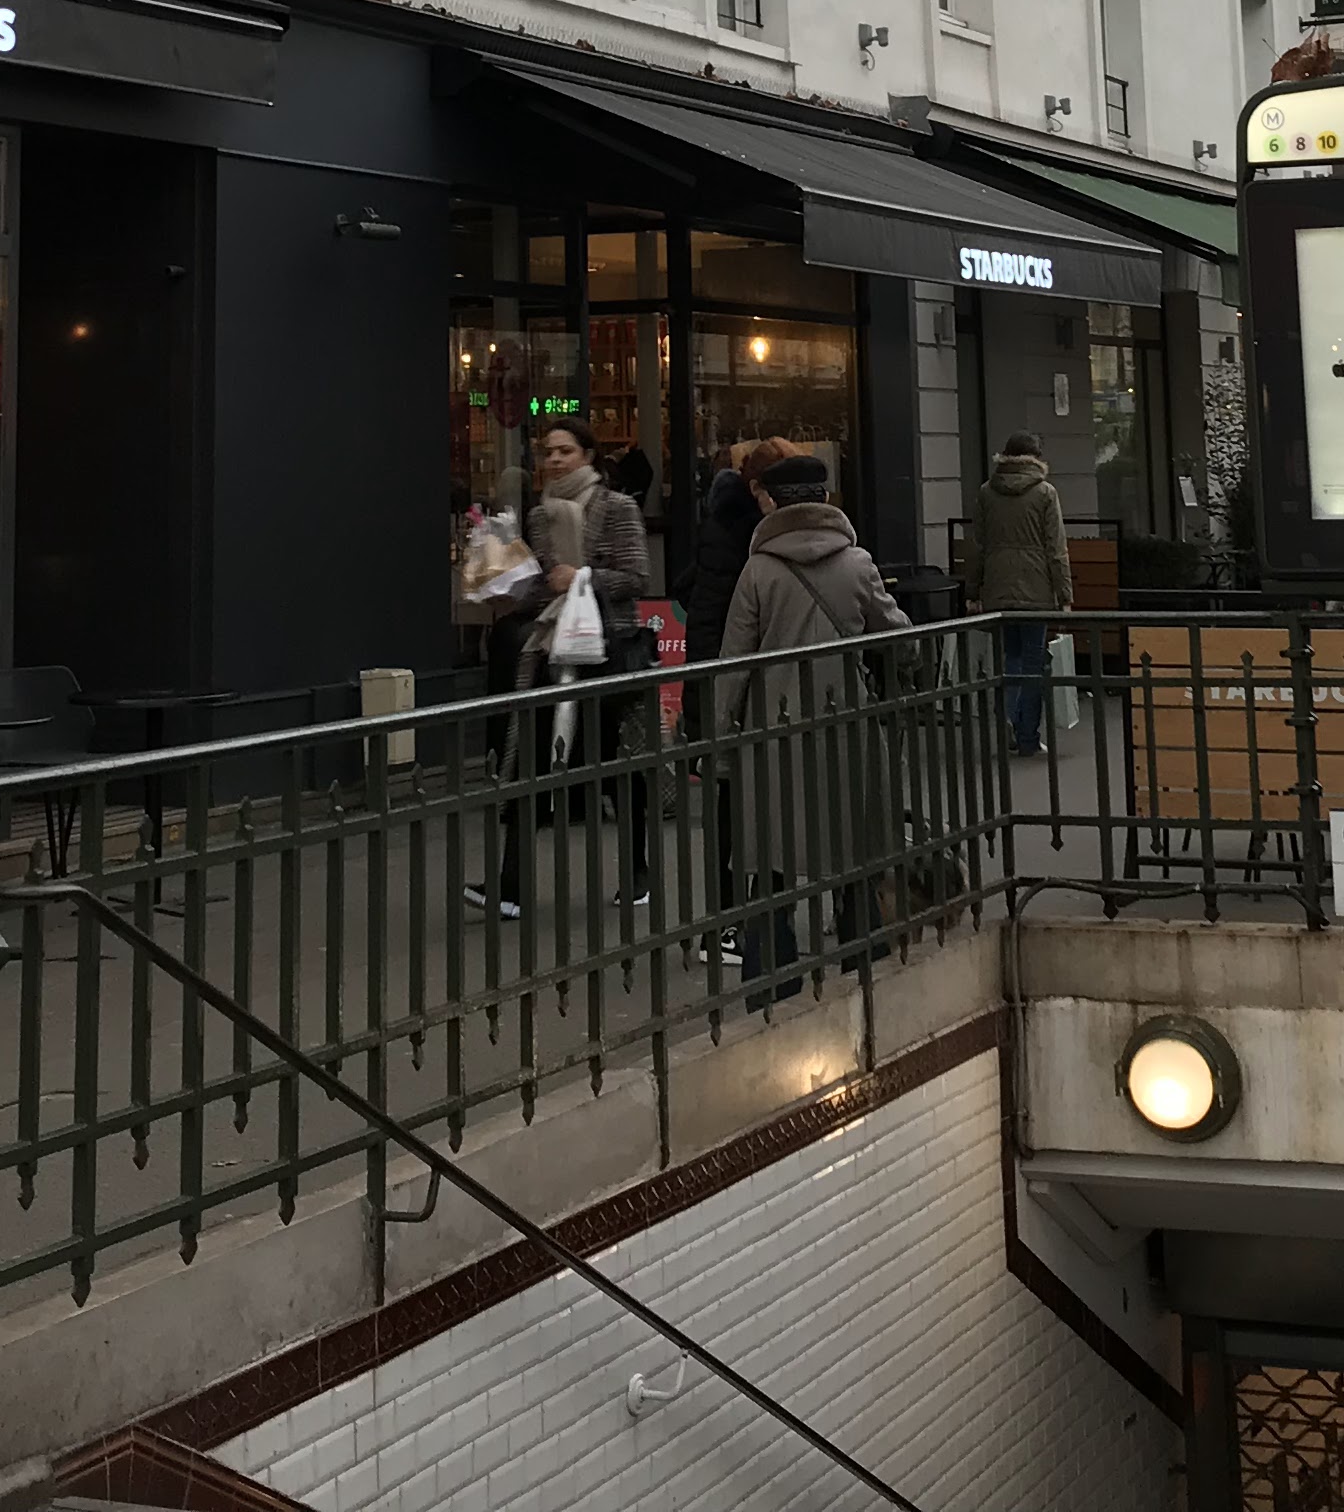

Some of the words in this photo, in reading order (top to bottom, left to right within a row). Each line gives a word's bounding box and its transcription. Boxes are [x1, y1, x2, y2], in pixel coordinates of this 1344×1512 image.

[1268, 138, 1279, 153] 6
[1295, 136, 1307, 151] 8
[1317, 134, 1337, 149] 10
[959, 247, 1053, 289] STARBUCKS
